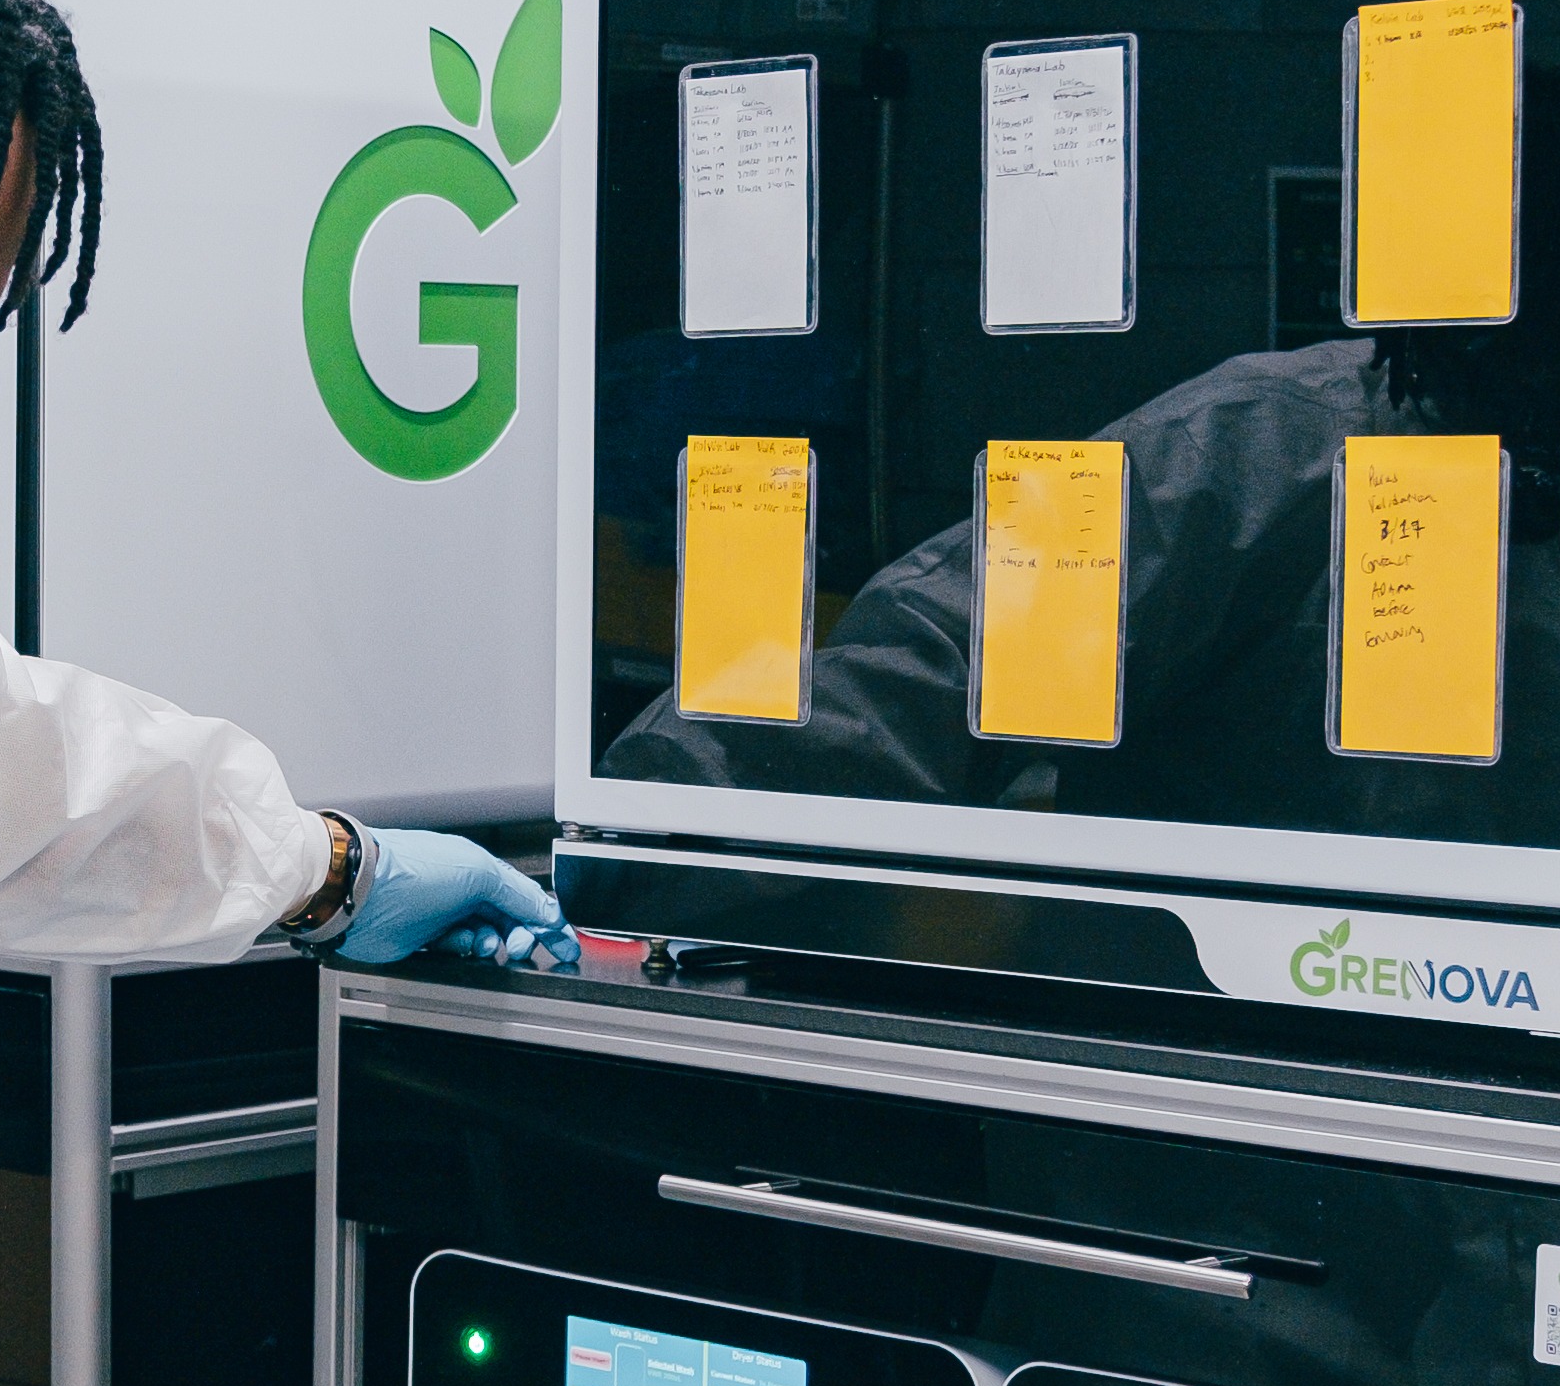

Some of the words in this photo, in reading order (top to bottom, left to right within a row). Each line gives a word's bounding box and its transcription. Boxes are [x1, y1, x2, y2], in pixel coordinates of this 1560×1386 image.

[1043, 60, 1066, 72] Lab
[301, 124, 520, 484] G
[1379, 516, 1426, 545] 3/17
[1289, 937, 1541, 1012] GRENOVA
[609, 1326, 632, 1339] Wash
[633, 1330, 659, 1346] Status
[731, 1349, 755, 1364] Dryer
[755, 1354, 782, 1370] Status
